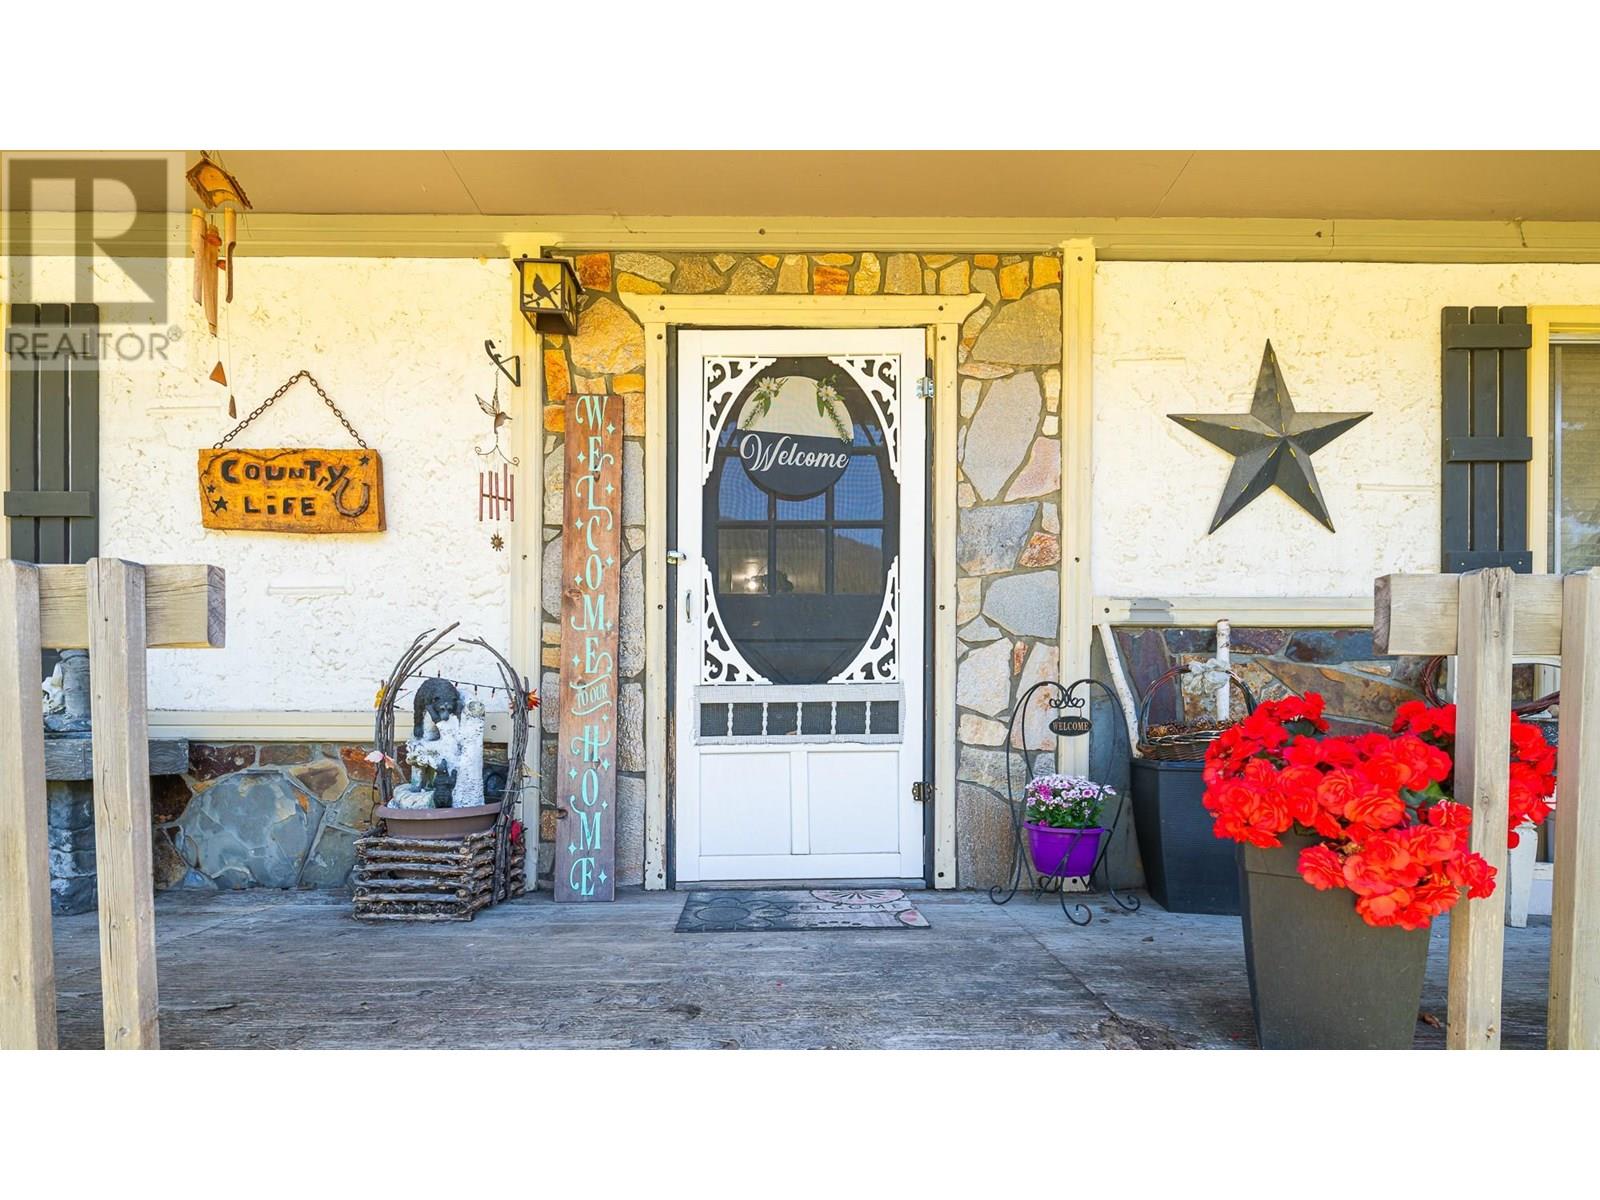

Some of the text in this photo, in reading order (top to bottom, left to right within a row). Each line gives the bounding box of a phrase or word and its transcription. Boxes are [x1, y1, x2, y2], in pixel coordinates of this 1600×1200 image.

[740, 433, 849, 472] Welcome
[571, 395, 614, 674] WELCOME
[590, 682, 608, 703] OUR
[1052, 721, 1089, 731] WELCOME
[570, 724, 611, 896] HOME
